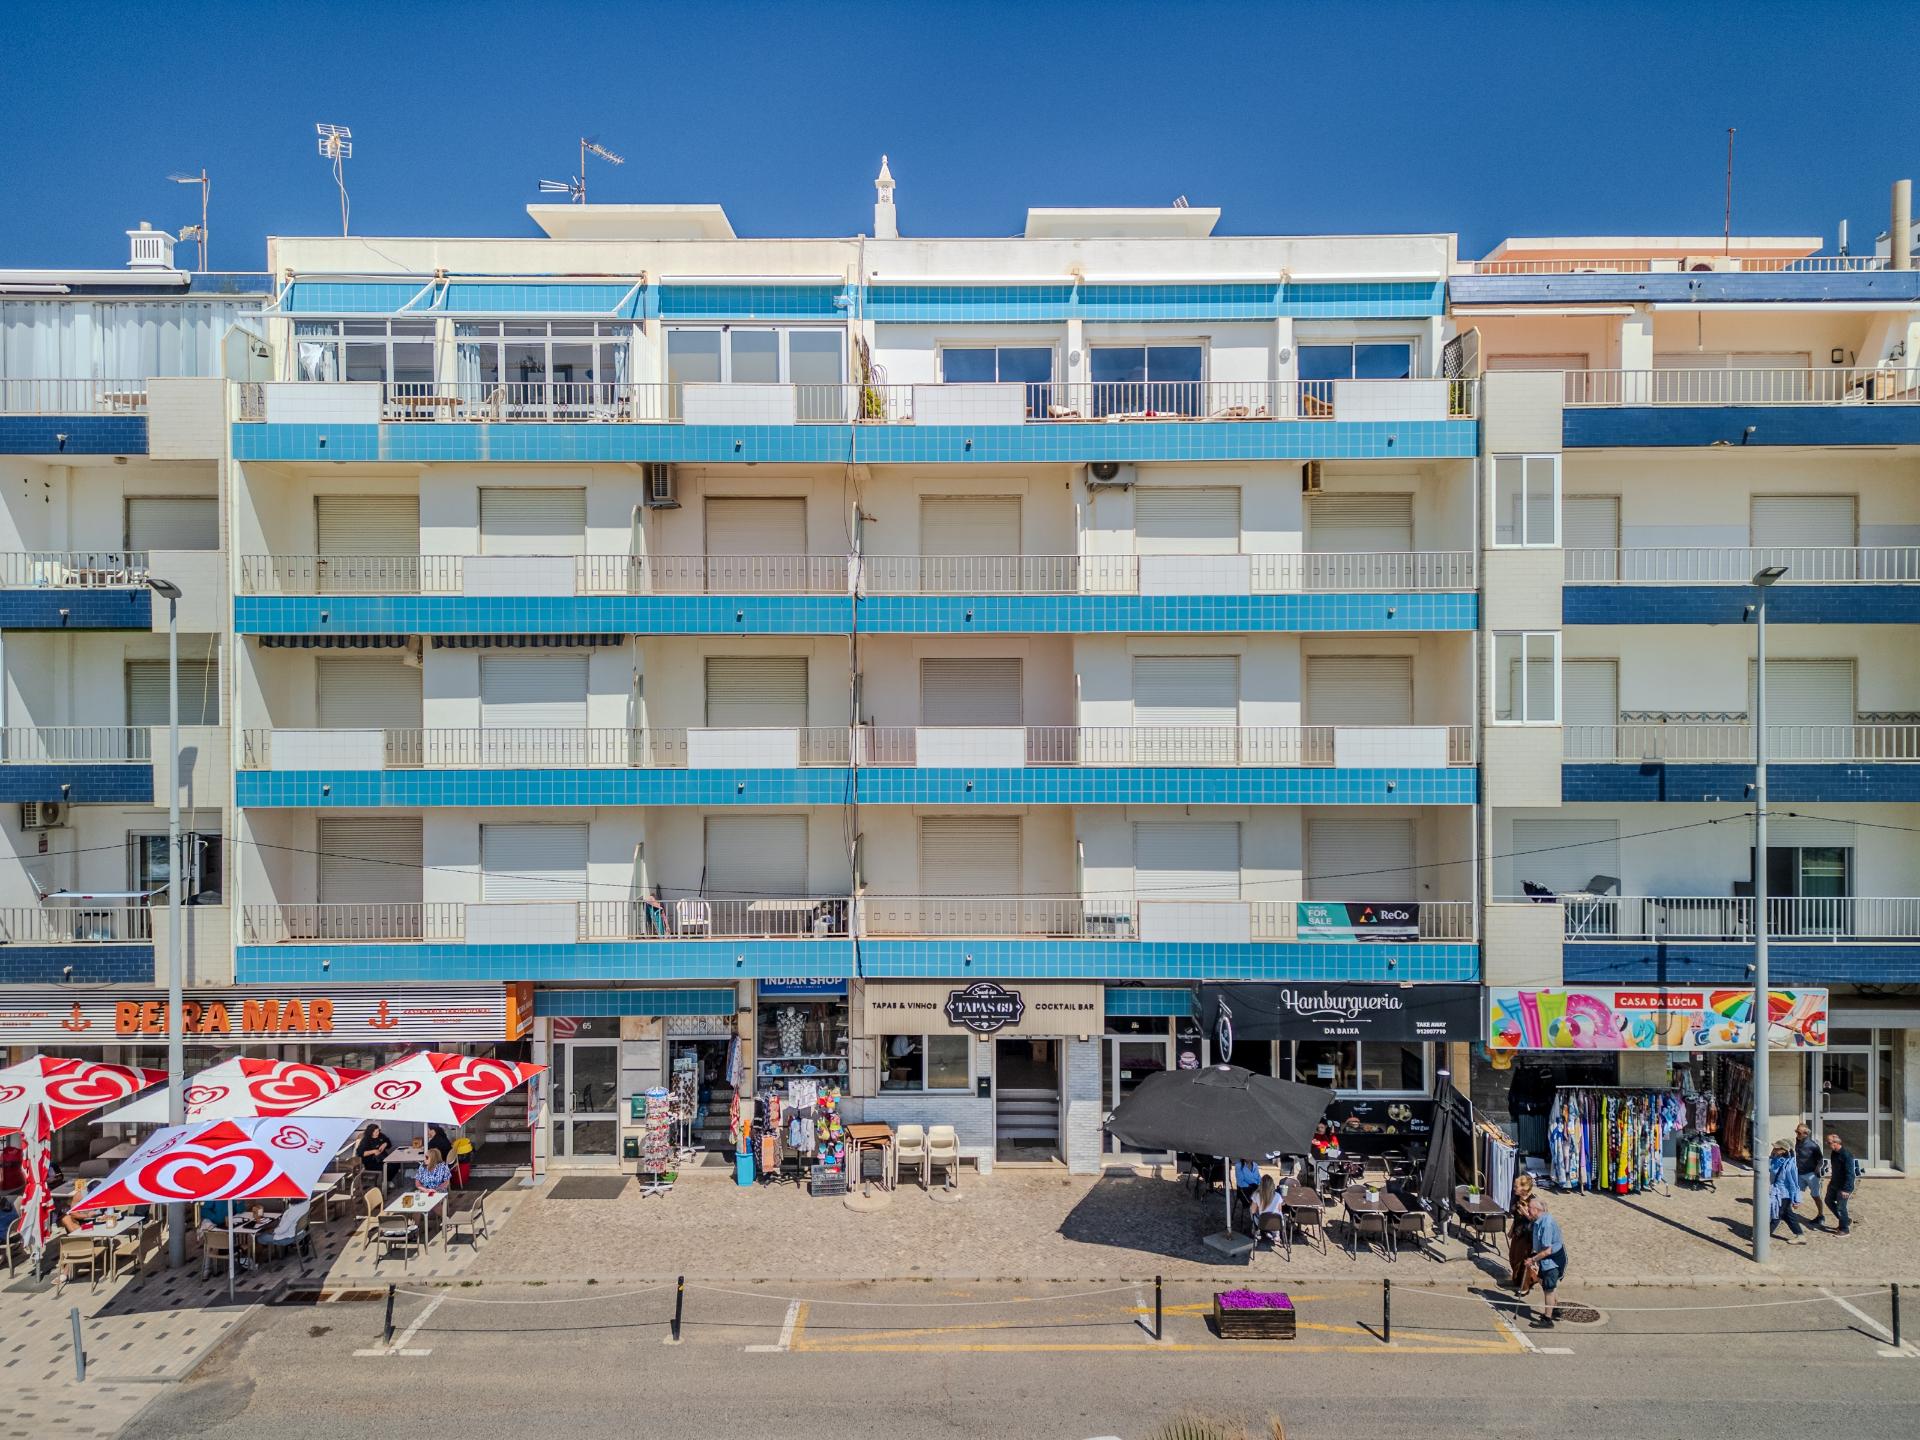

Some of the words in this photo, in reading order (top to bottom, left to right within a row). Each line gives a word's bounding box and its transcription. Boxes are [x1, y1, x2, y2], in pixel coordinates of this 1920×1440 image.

[1308, 909, 1328, 917] FOR
[1380, 910, 1409, 920] ReCo
[1308, 917, 1332, 925] SALE
[764, 977, 806, 985] INDIAN
[810, 977, 842, 985] SHOP
[1280, 989, 1403, 1019] Hamburgueria
[1620, 997, 1647, 1006] CASA
[1650, 997, 1664, 1006] DA
[1667, 996, 1698, 1006] LÚCIA
[908, 1002, 937, 1010] VINHOS
[956, 1002, 995, 1013] TAPAS
[996, 1002, 1013, 1013] 69
[1035, 1003, 1075, 1011] COCKTAIL
[1078, 1003, 1094, 1011] BAR
[115, 1001, 231, 1033] BEIRA
[242, 999, 334, 1033] MAR
[582, 1022, 592, 1030] 65
[1324, 1027, 1335, 1035] DA
[1337, 1027, 1360, 1035] BAIXA
[370, 1101, 399, 1110] OLÁ
